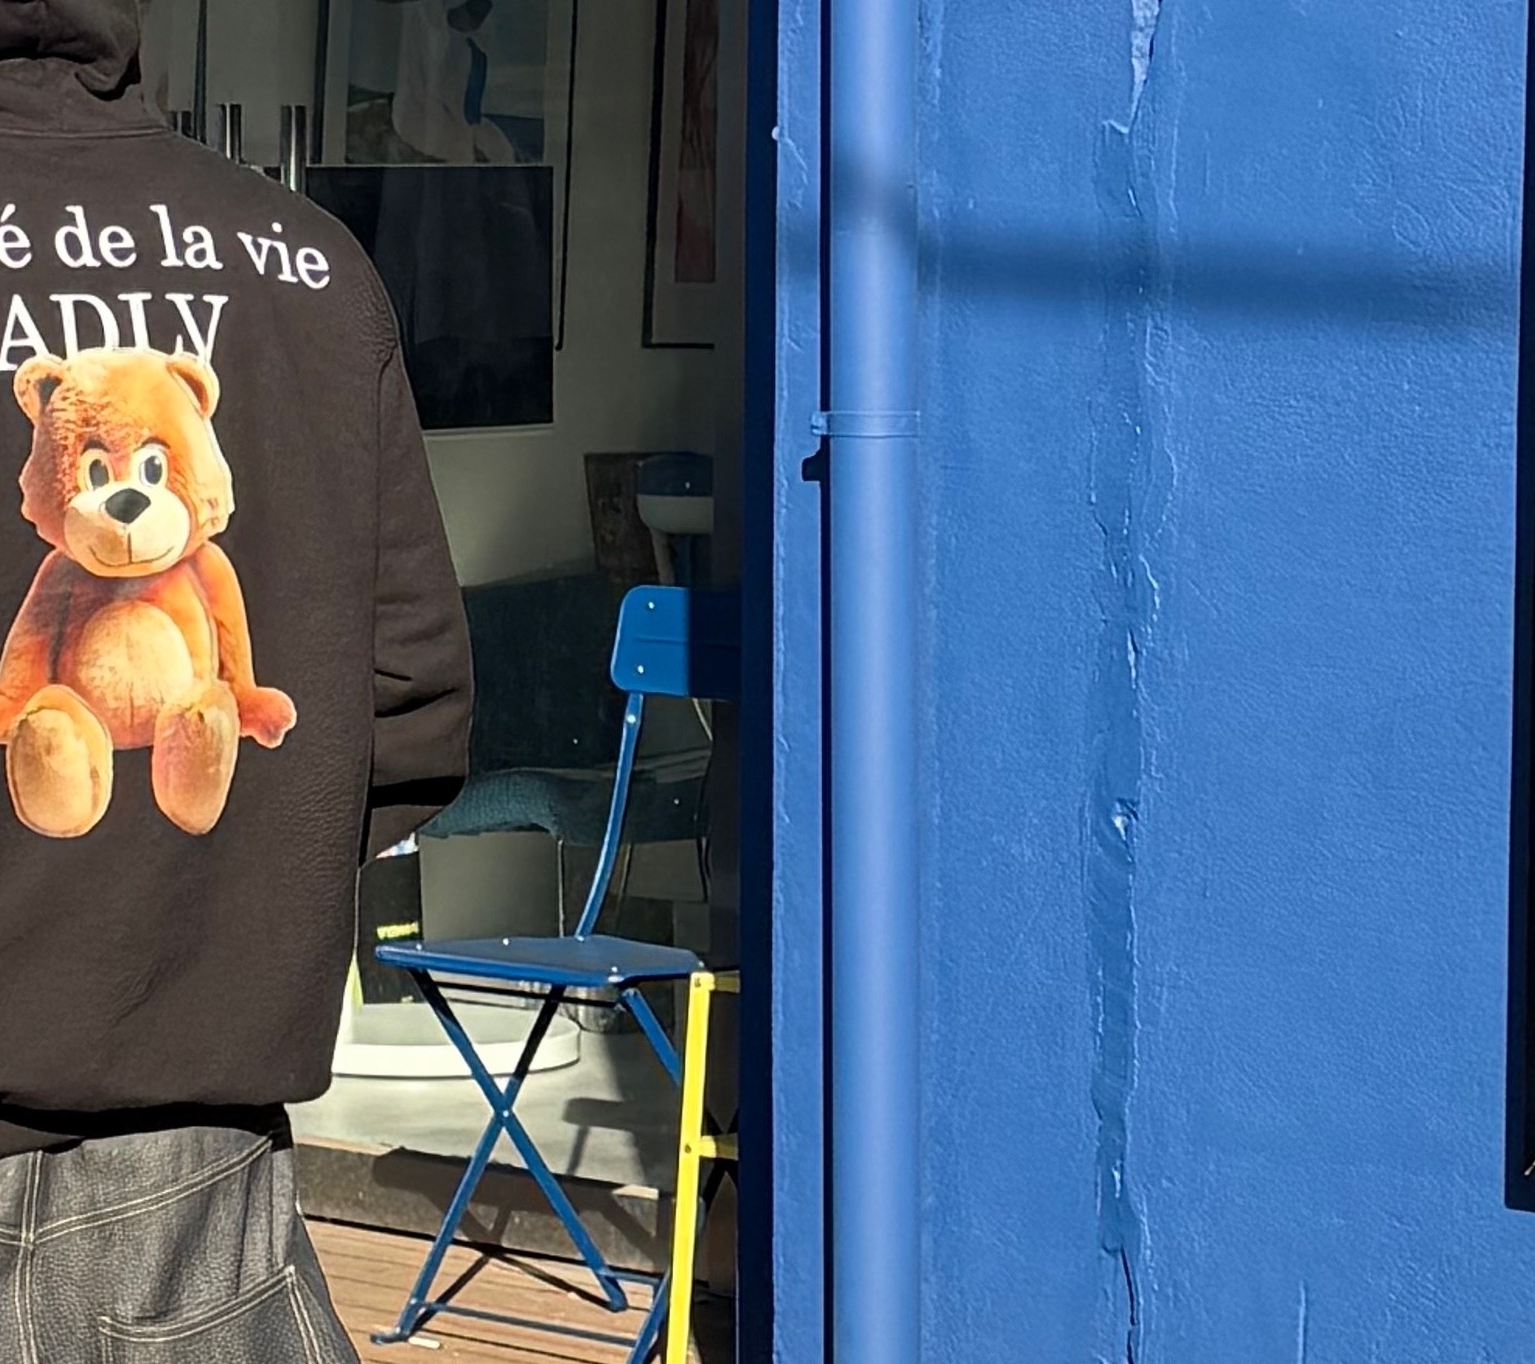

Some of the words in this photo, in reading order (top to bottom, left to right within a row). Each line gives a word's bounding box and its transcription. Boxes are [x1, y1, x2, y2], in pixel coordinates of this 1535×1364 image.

[54, 205, 137, 268] de
[150, 204, 223, 271] la
[238, 222, 331, 290] vie
